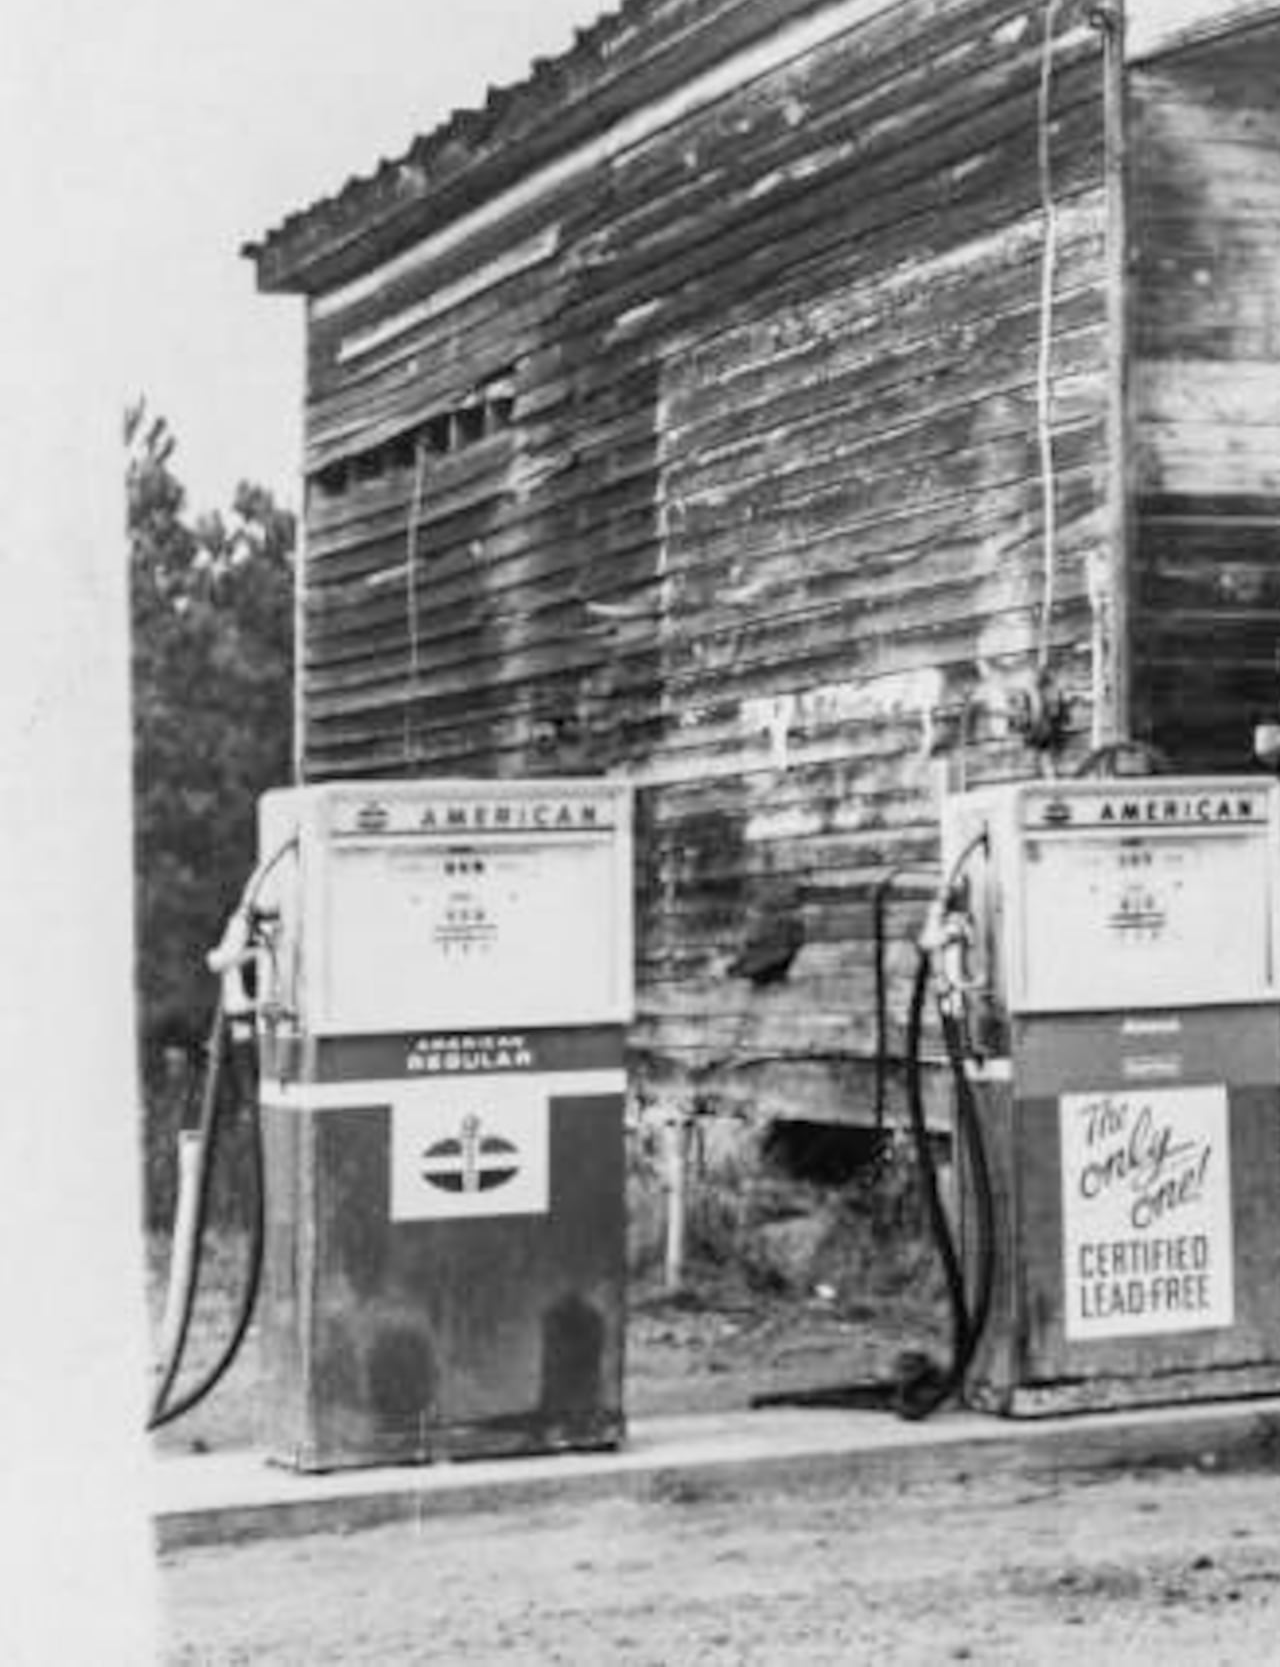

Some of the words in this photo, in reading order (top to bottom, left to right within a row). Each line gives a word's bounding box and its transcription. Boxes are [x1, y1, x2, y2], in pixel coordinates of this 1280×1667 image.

[420, 804, 597, 826] AMERICAN
[1101, 799, 1251, 821] AMERICAN
[406, 1050, 533, 1070] REGULAR
[1080, 1099, 1128, 1146] The
[1080, 1105, 1192, 1198] only
[1131, 1144, 1211, 1228] one!
[1080, 1235, 1208, 1278] CERTIFIED
